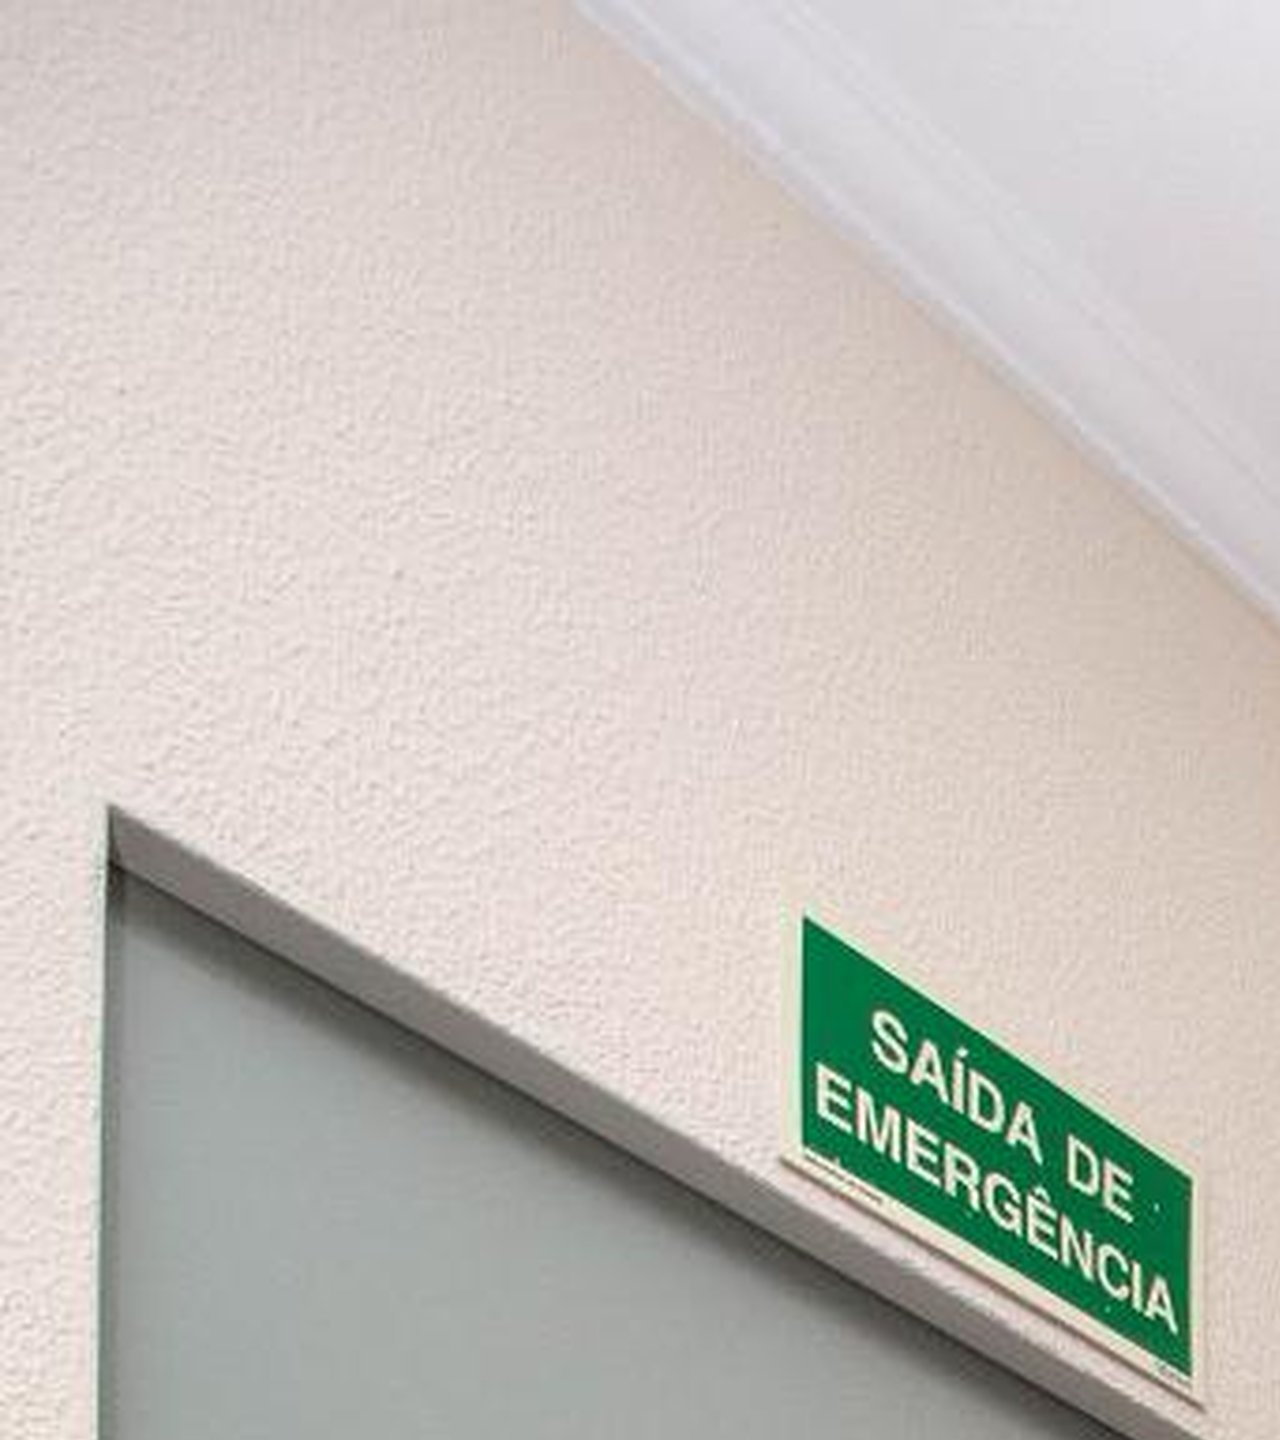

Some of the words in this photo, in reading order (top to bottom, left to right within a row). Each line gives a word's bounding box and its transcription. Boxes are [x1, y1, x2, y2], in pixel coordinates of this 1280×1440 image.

[815, 1062, 1179, 1335] EMERGÊNCIA
[871, 1009, 1044, 1165] SAÍDA
[1066, 1133, 1135, 1225] DE
